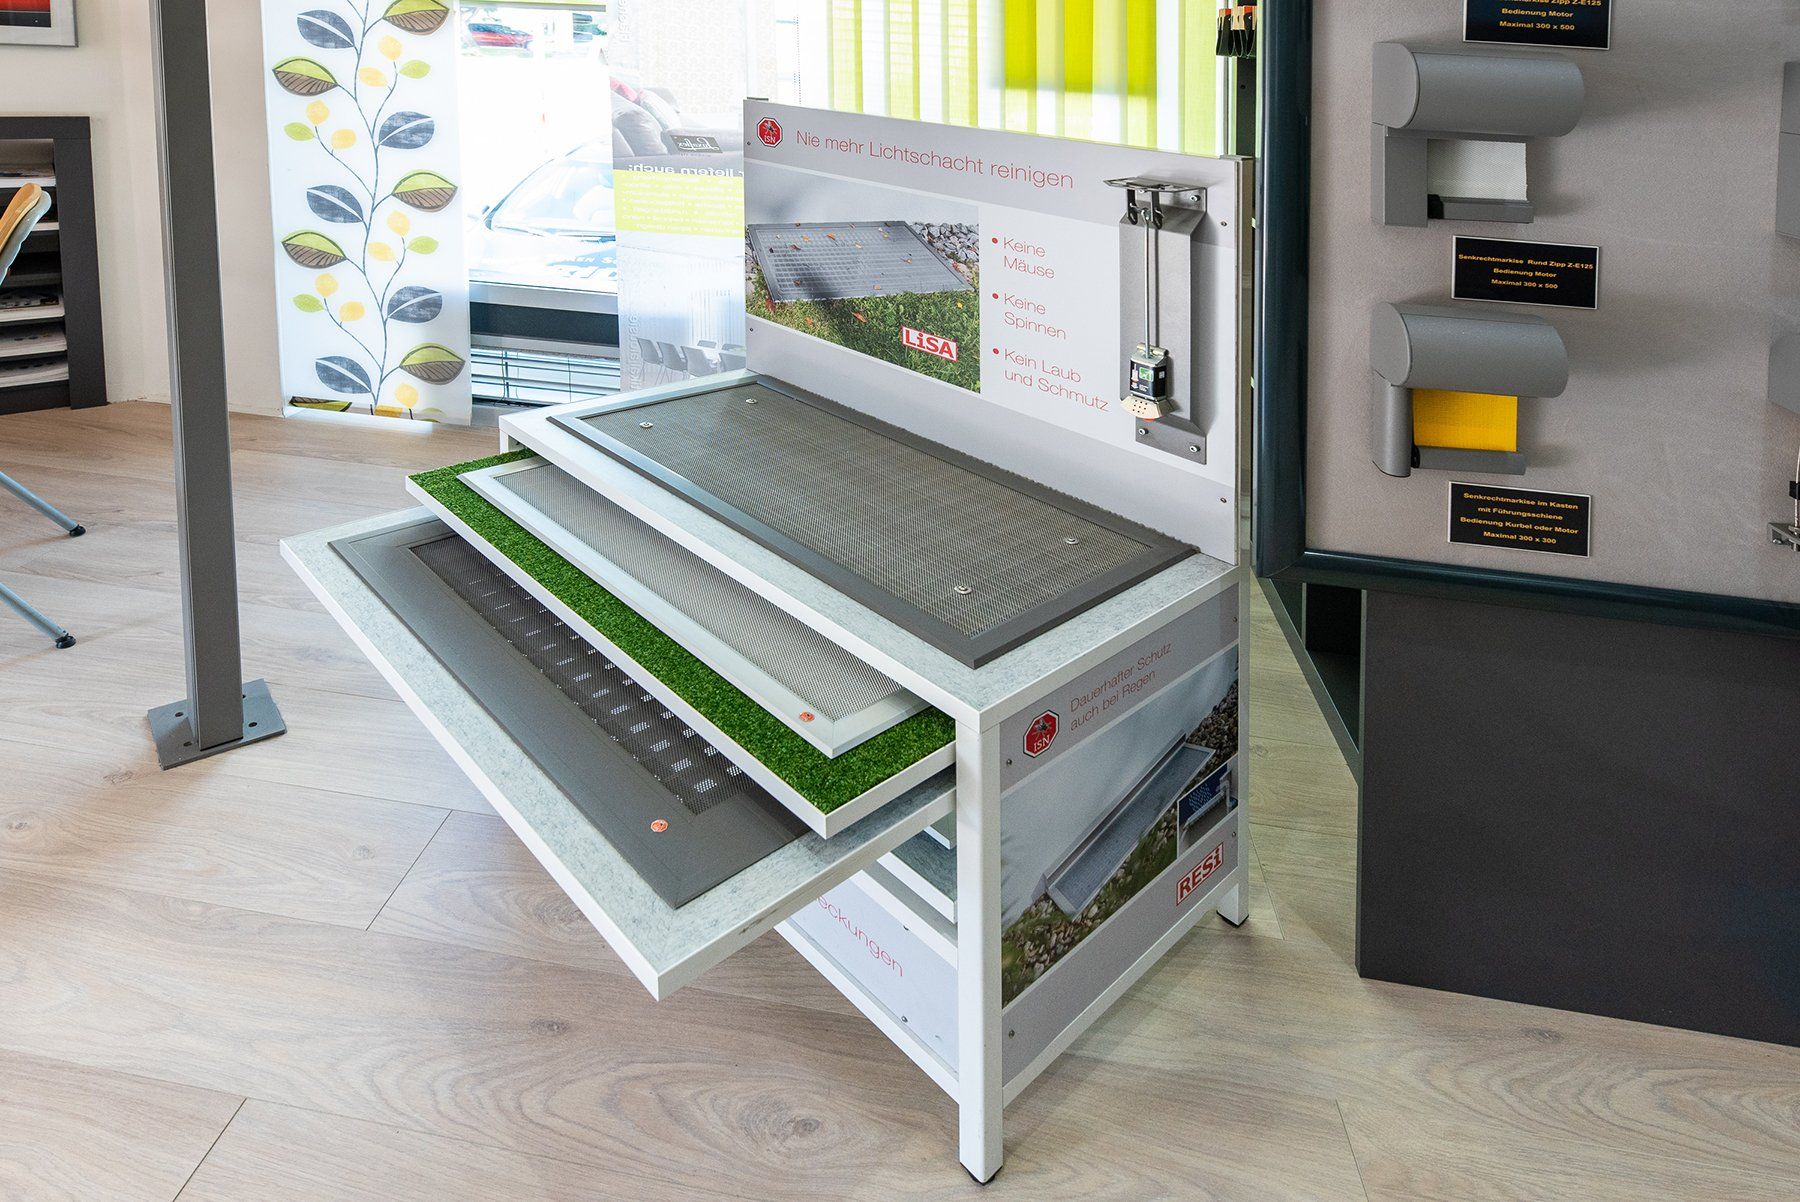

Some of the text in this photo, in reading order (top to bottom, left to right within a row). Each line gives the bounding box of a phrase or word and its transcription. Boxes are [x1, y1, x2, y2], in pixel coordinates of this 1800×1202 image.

[1501, 8, 1574, 18] Bedienung Motor
[1499, 20, 1534, 29] Maximal
[796, 129, 1075, 190] Nie mehr Lichtschacht reinigen
[1002, 237, 1046, 259] Keine
[1003, 255, 1056, 280] Mäuse
[1493, 268, 1534, 277] Bedienung
[1549, 260, 1566, 268] Zipp
[1567, 262, 1594, 270] Z-E125
[1491, 278, 1522, 286] Maximal
[1003, 293, 1046, 316] Keine
[1003, 311, 1067, 341] Spinnen
[905, 329, 955, 359] LiSA
[1003, 348, 1082, 383] Kein Laub
[1004, 368, 1110, 412] und Schmutz
[1492, 507, 1563, 521] Führungsschiene
[1549, 501, 1579, 510] Kasten
[1459, 516, 1579, 535] Bedienung Kurbel oder Motor
[1482, 531, 1517, 540] Maximal
[1518, 534, 1533, 542] 300
[1542, 537, 1557, 545] 300
[1070, 643, 1172, 713] Dauerhafter Schutz
[1070, 670, 1156, 732] auch bei Regen
[817, 896, 904, 977] eckungen
